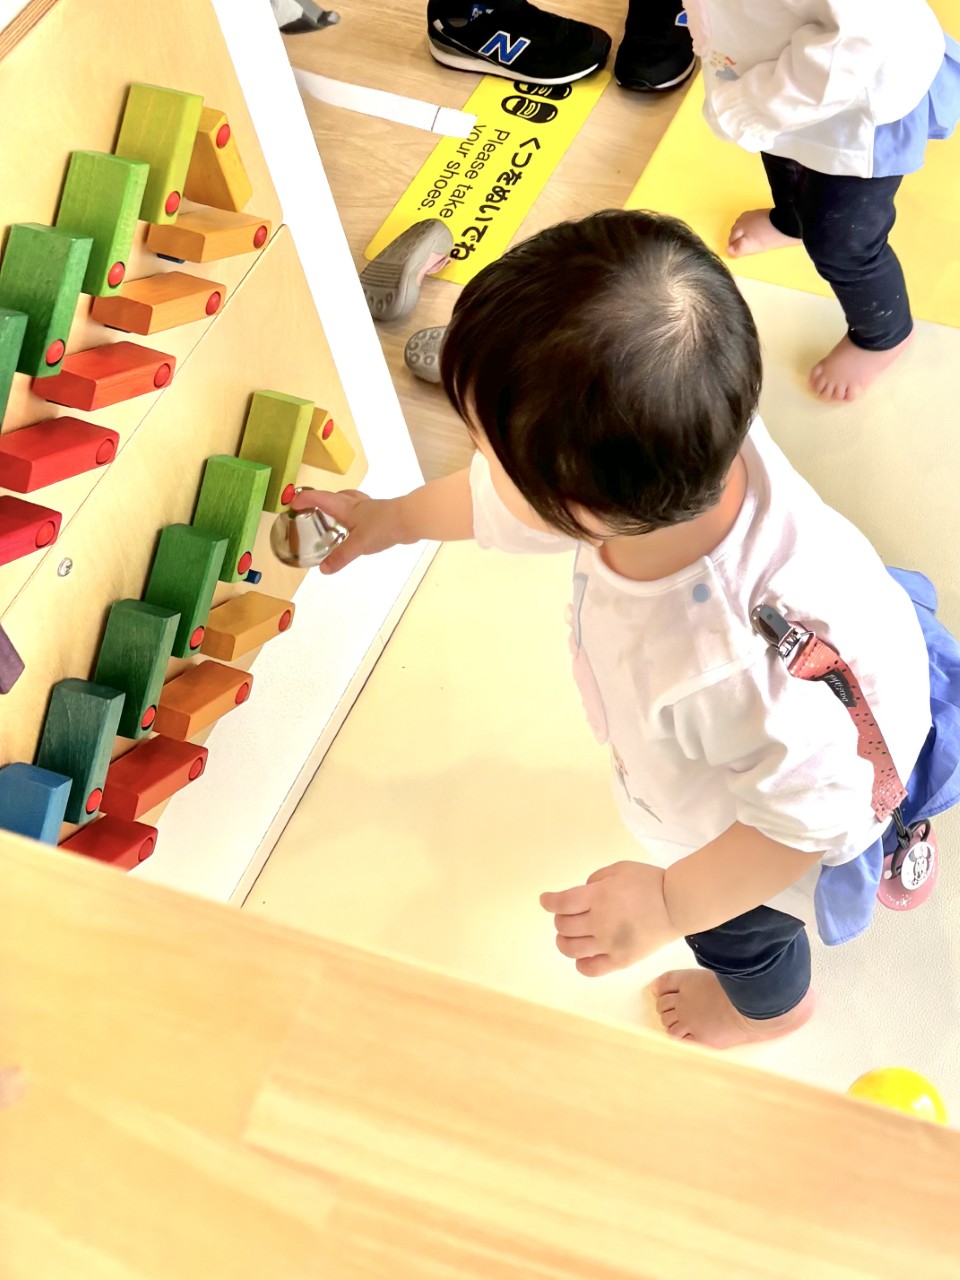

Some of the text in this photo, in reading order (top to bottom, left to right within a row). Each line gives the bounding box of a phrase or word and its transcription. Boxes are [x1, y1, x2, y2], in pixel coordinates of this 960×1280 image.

[478, 30, 531, 65] N
[417, 125, 487, 211] your shoes.
[439, 129, 511, 218] Please take
[450, 137, 541, 260] くつをぬいでね
